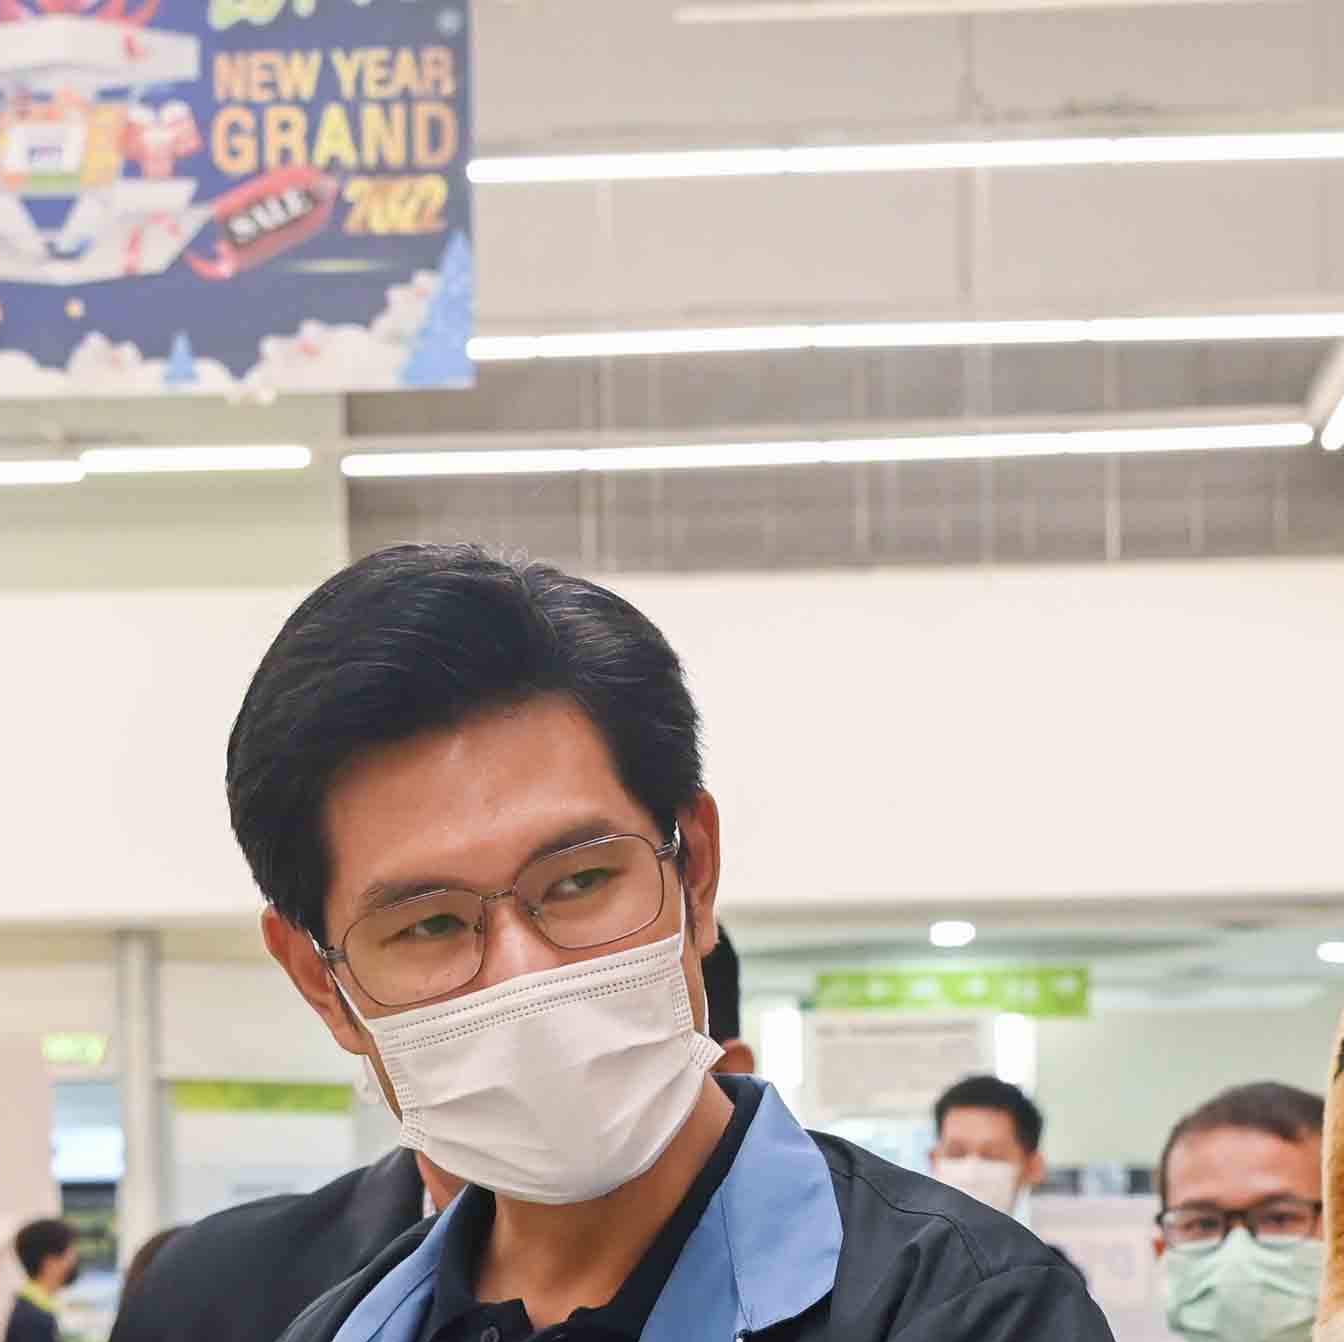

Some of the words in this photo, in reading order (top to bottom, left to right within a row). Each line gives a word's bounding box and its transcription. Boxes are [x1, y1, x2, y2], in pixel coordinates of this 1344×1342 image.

[212, 49, 323, 102] NEW
[329, 46, 455, 99] YEAR
[210, 101, 457, 175] GRAND
